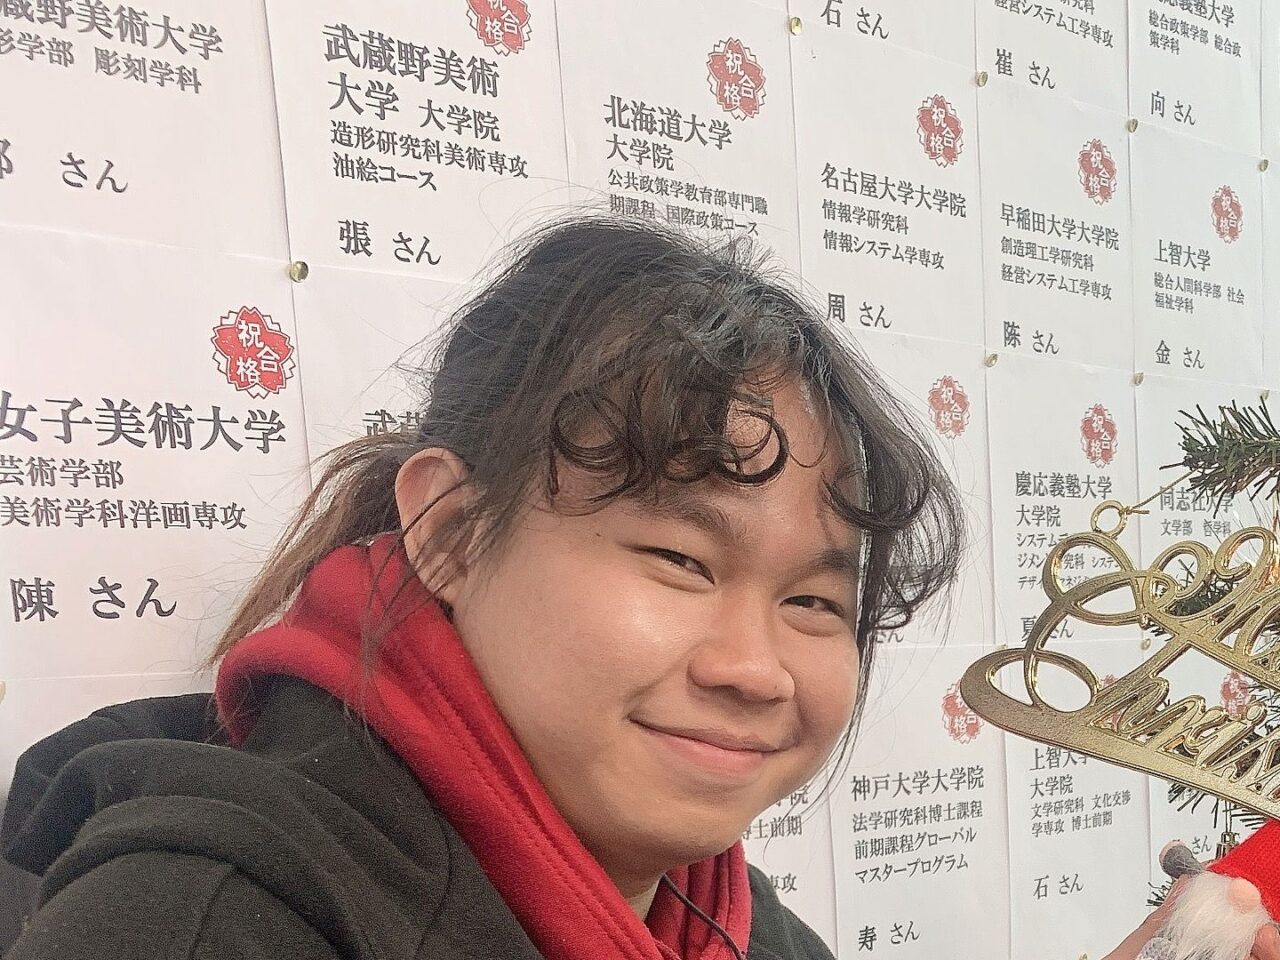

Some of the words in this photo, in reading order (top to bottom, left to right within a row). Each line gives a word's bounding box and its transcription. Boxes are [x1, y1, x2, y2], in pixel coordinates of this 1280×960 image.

[820, 0, 843, 28] 石
[856, 7, 889, 40] さん
[94, 47, 202, 94] 彫刻学科
[323, 24, 499, 97] 武蔵野美術
[1028, 61, 1056, 90] さん
[327, 73, 399, 121] 大学
[418, 100, 500, 142] 大学院
[604, 94, 732, 151] 北海道大学
[1151, 91, 1165, 118] 向
[1174, 100, 1196, 125] さん
[329, 120, 528, 179] 造形研究科美術専攻
[605, 134, 675, 171] 大学院
[60, 152, 128, 193] さん
[332, 152, 437, 191] 油絵コース
[608, 168, 768, 216] 公共政策学教育部専門職
[820, 162, 967, 219] 名古屋大学大学院
[821, 198, 910, 235] 情報学研究科
[1000, 202, 1120, 251] 早稲田大学大学院
[338, 219, 372, 257] 張
[392, 231, 441, 265] さん
[822, 229, 945, 270] 情報システム学専攻
[1000, 236, 1094, 272] 創造理工学研究科
[1154, 238, 1211, 272] 上智大学
[1000, 263, 1112, 301] 経営システム工学専攻
[1154, 272, 1222, 300] 総合人間科学部
[1227, 287, 1245, 305] 社会
[827, 292, 847, 323] 周
[859, 304, 892, 330] さん
[1155, 291, 1194, 314] 福祉学科
[1032, 330, 1060, 355] さん
[1156, 339, 1171, 365] 金
[1183, 346, 1205, 369] さん
[0, 391, 286, 454] 女子美術大学
[0, 455, 124, 489] 芸術学部
[1015, 471, 1112, 500] 慶応義塾大学
[0, 496, 247, 530] 美術学科洋画専攻
[1016, 504, 1061, 528] 大学院
[1160, 519, 1193, 536] 文学部
[11, 577, 58, 622] 陳
[89, 577, 177, 619] さん
[851, 765, 984, 802] 神戸大学大学院
[1030, 774, 1074, 799] 大学院
[853, 802, 983, 832] 法学研究科博士課程
[1031, 795, 1085, 819] 文学研究科
[1091, 791, 1132, 811] 文化交渉
[1031, 818, 1065, 838] 学専攻
[1071, 812, 1113, 832] 博士前期
[854, 827, 977, 860] 前期課程グローバル
[1192, 836, 1213, 854] さん
[855, 853, 969, 884] マスタープログラム
[1034, 875, 1049, 900] 石
[1059, 873, 1084, 895] さん
[858, 926, 877, 952] 寿
[890, 920, 920, 946] さん
